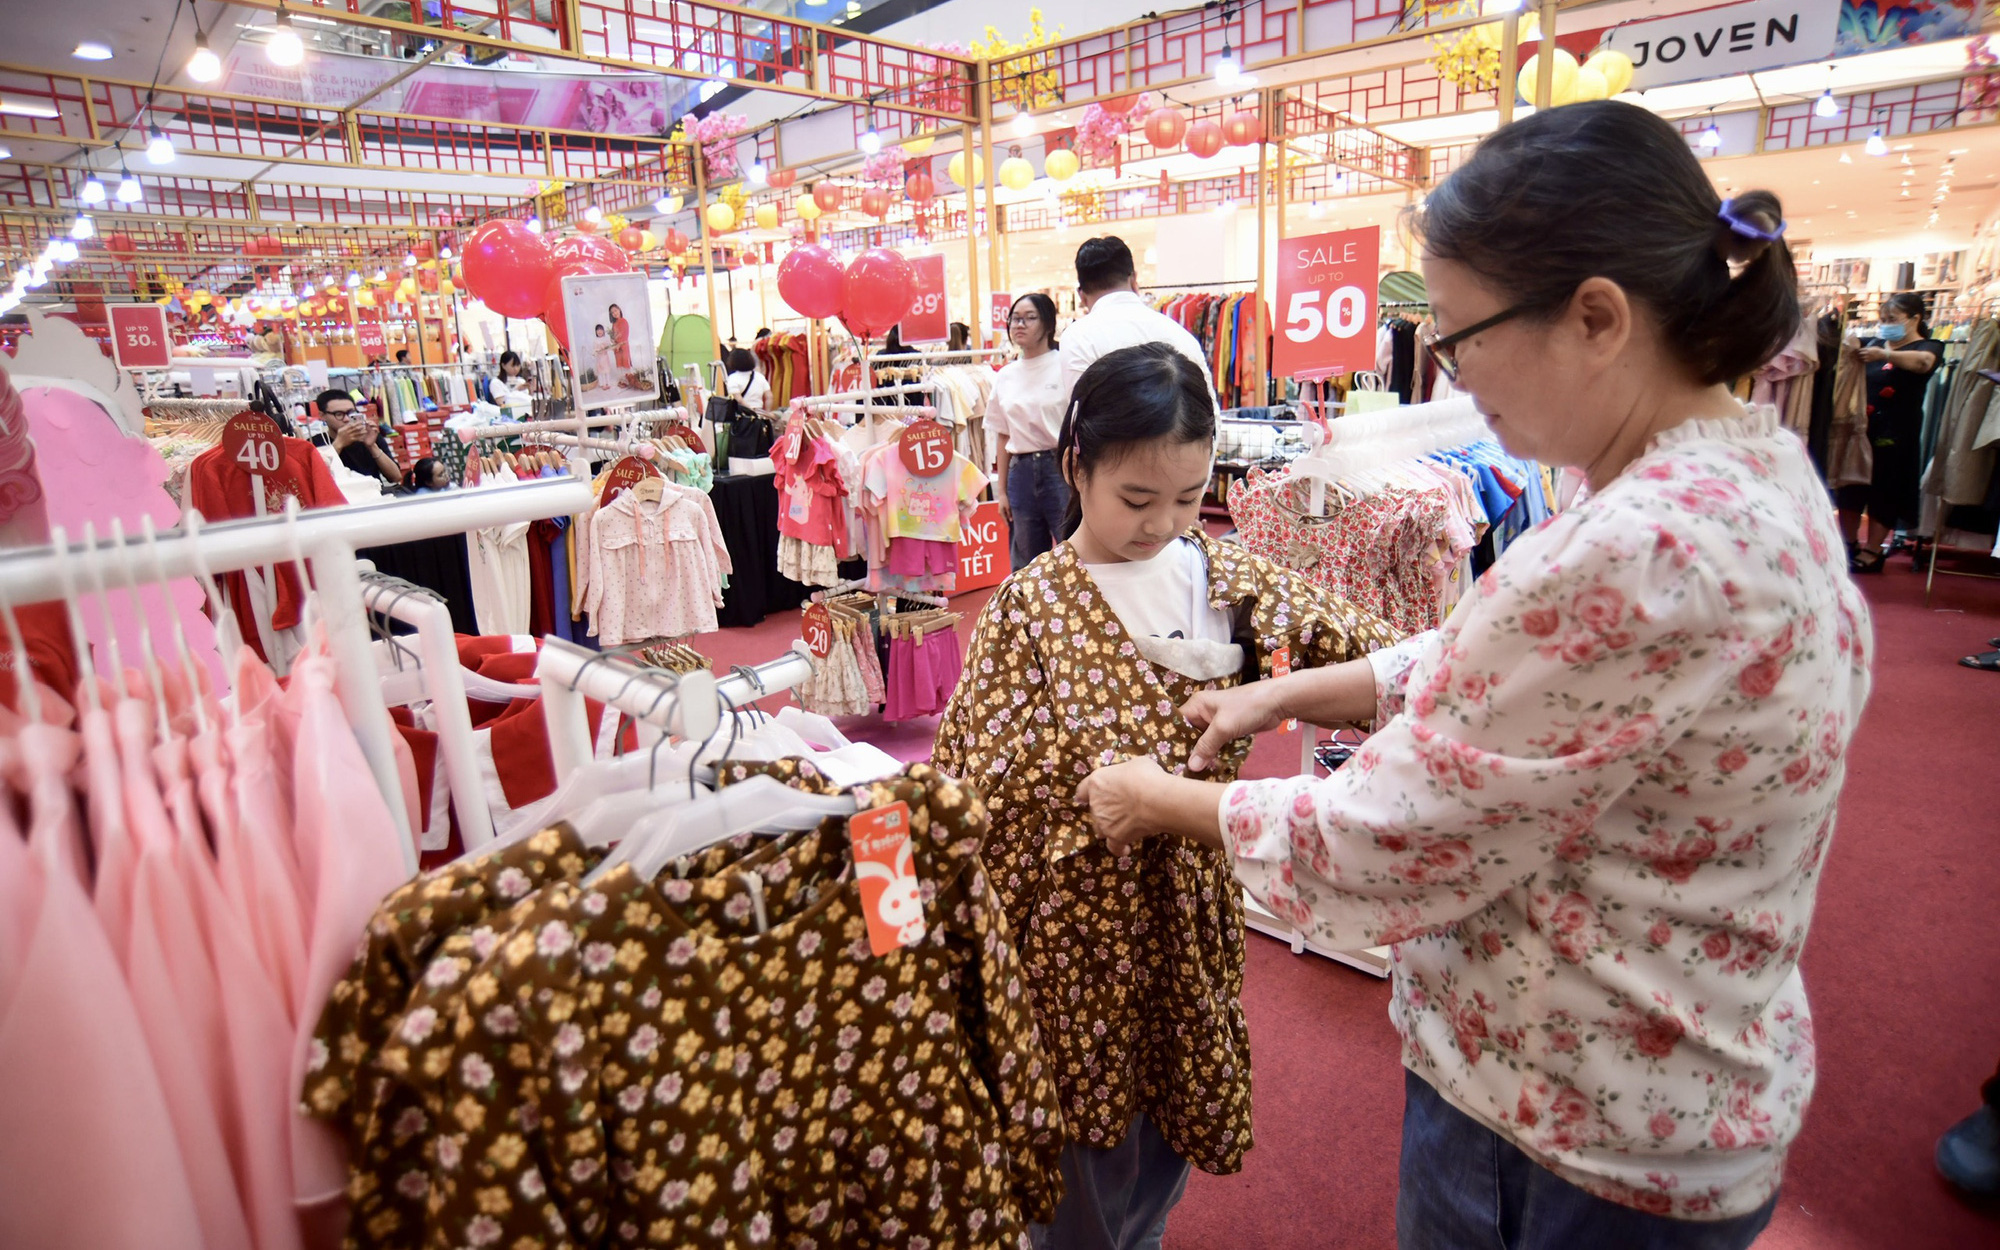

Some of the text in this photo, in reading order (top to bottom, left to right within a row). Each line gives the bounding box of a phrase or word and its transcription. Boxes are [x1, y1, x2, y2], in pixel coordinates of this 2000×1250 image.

[1632, 14, 1798, 68] JOVEN
[281, 81, 322, 95] TRAG
[352, 90, 382, 102] THO
[554, 243, 606, 262] SALE
[1297, 242, 1358, 269] SALE
[1308, 271, 1344, 285] UP TO
[234, 421, 275, 433] SALE TẾT
[906, 431, 926, 442] SALE
[927, 426, 941, 438] TẾT
[615, 468, 635, 480] SALE
[961, 546, 994, 578] TẾT
